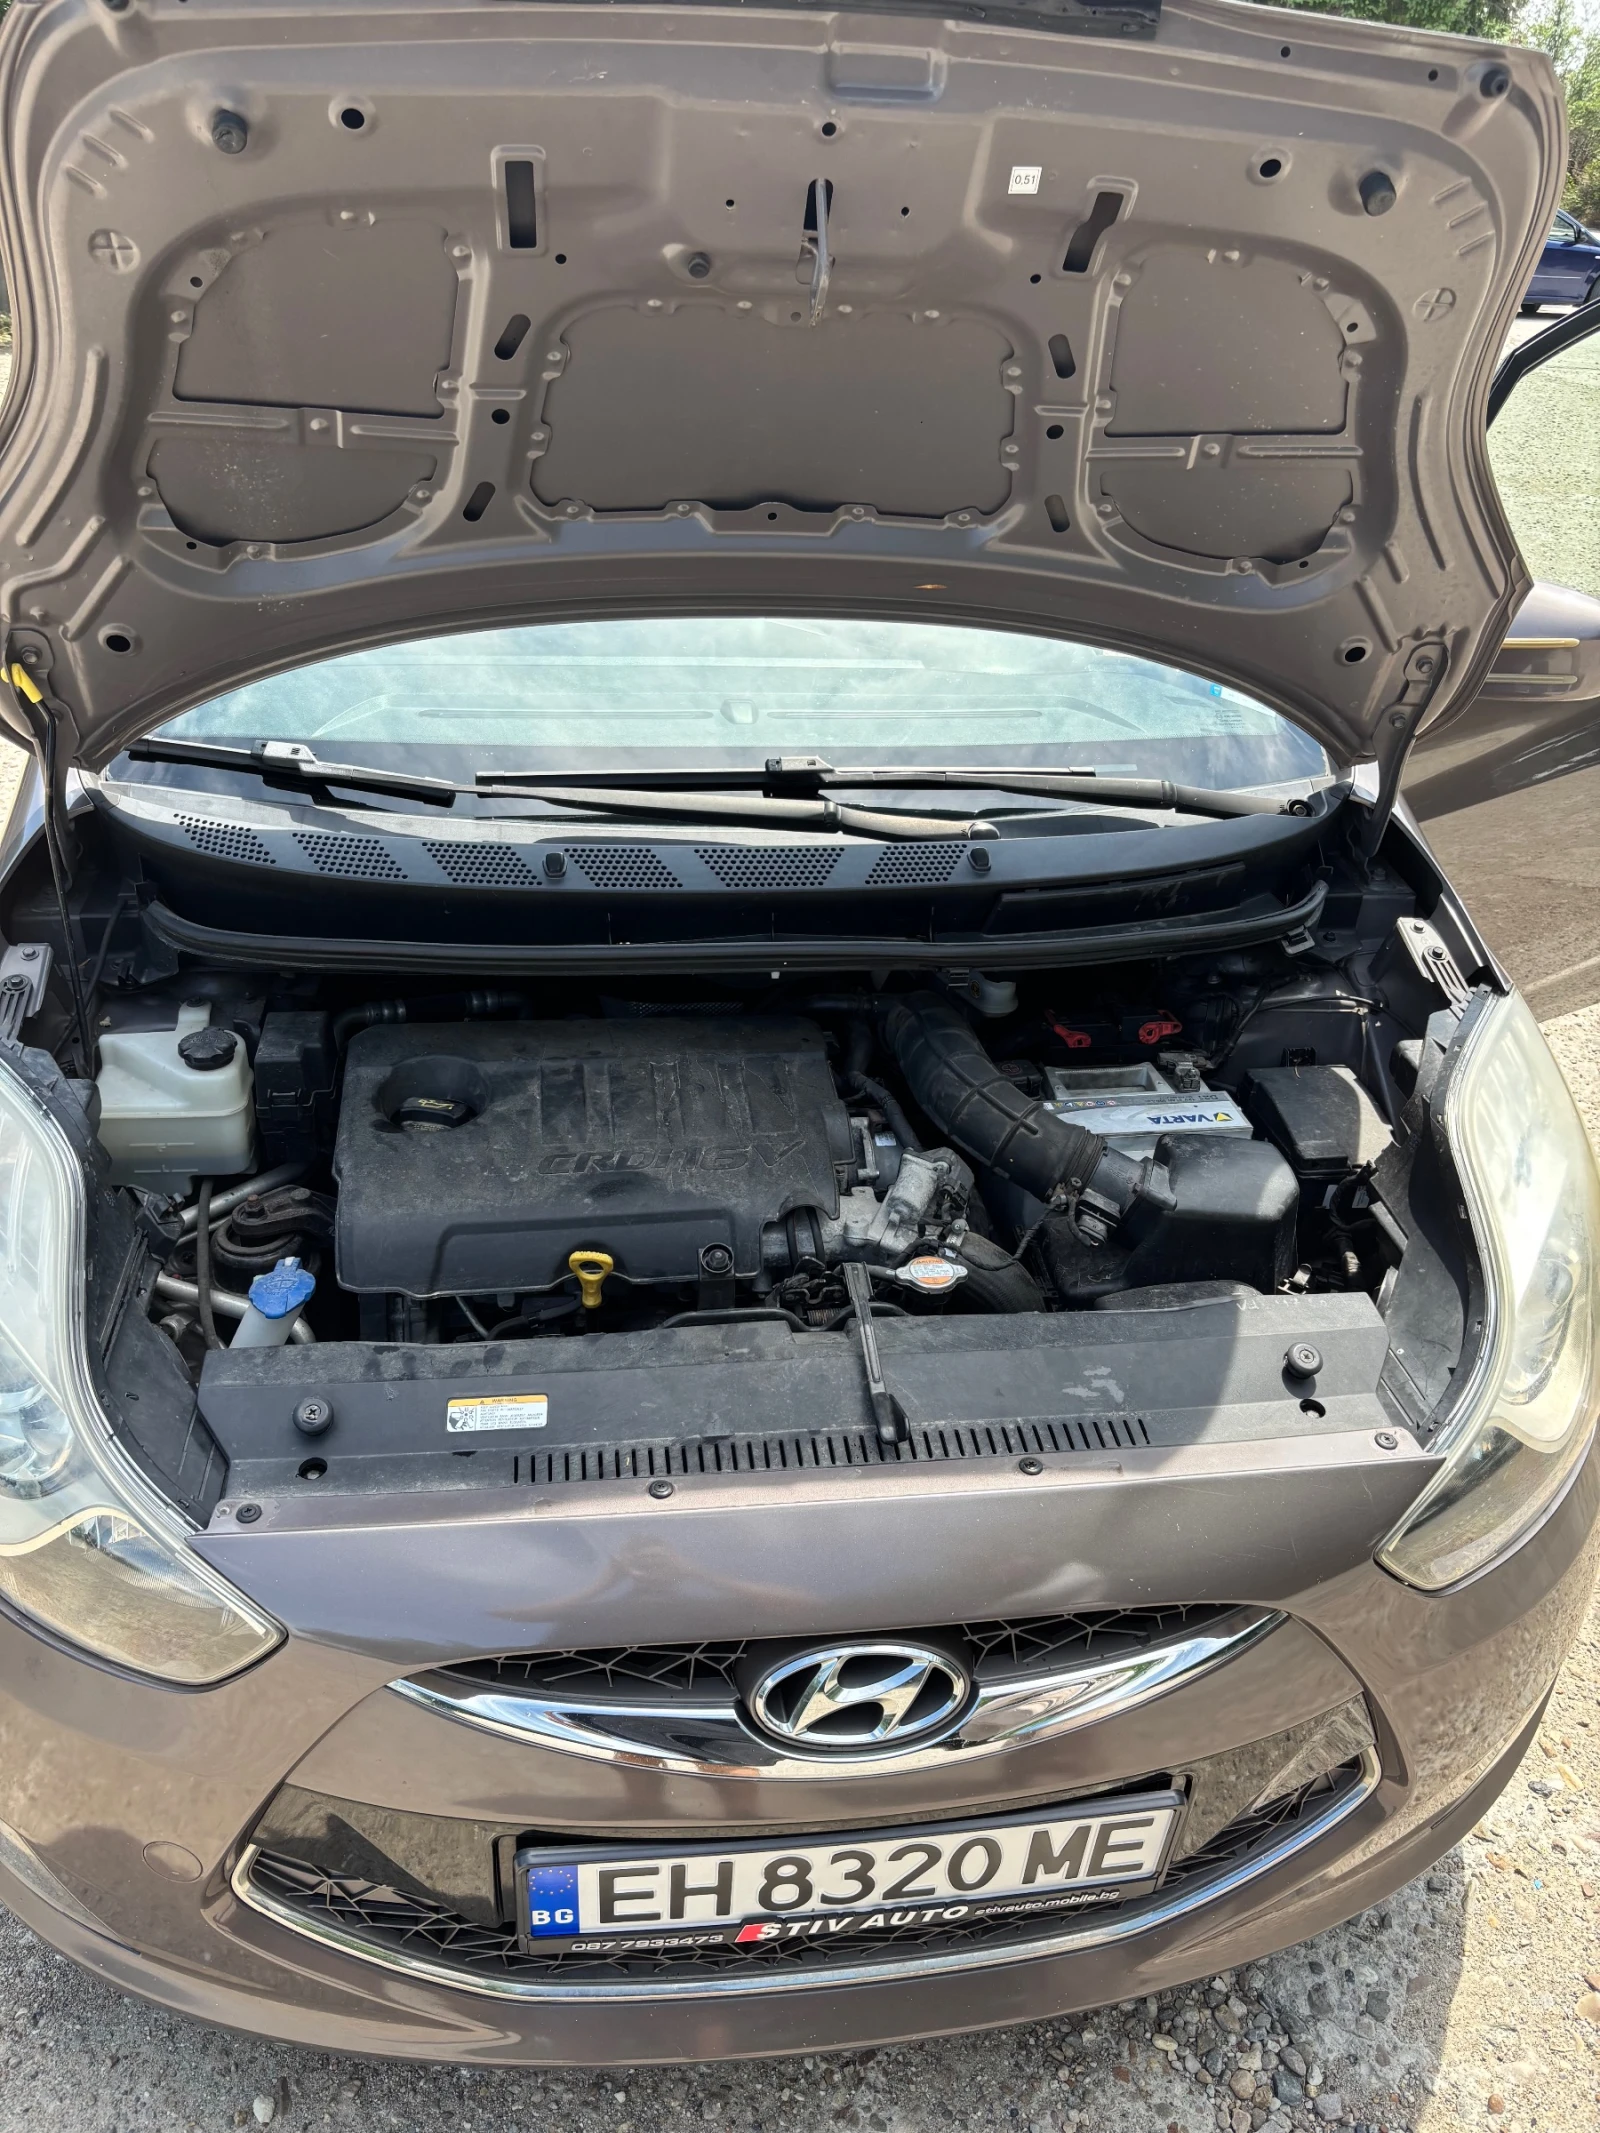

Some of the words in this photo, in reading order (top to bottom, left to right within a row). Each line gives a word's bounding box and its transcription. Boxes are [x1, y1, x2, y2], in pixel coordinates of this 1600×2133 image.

[1148, 1114, 1213, 1125] VARTA
[599, 1861, 735, 1923] EH
[758, 1837, 1002, 1912] 8320
[1021, 1817, 1155, 1885] ME
[532, 1908, 574, 1926] BG
[757, 1917, 854, 1939] STIV
[859, 1905, 969, 1929] AUTO
[974, 1889, 1120, 1915] stivauto.mobile.bg
